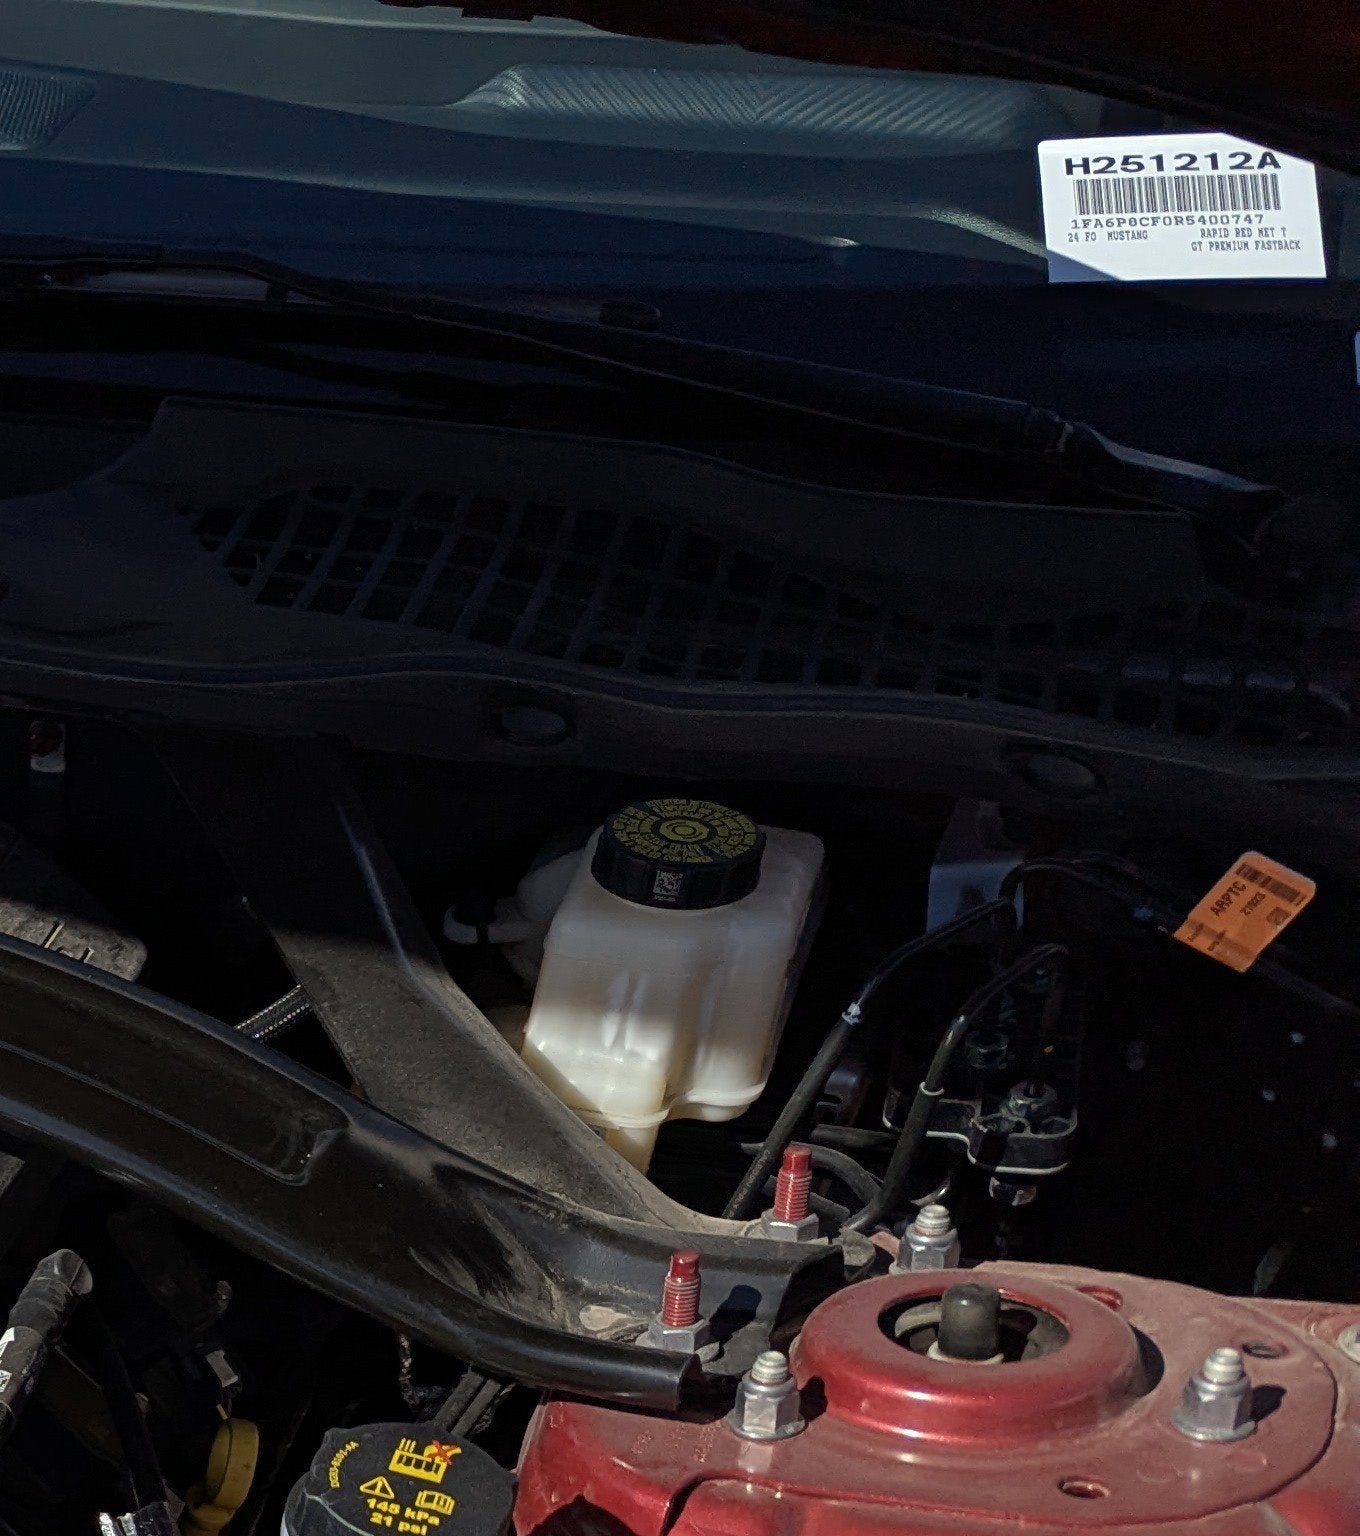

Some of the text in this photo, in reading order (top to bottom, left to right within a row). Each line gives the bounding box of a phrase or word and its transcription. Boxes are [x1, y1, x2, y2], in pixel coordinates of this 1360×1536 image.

[1064, 151, 1281, 175] H251212A
[1070, 214, 1264, 229] 1FA6P8CF0R5400747
[1067, 232, 1079, 242] 24
[1107, 230, 1148, 241] MUSTANG
[1200, 226, 1288, 238] RAPID RED MET T
[1191, 239, 1301, 251] GT PREMIUM FASTBACK
[370, 1511, 428, 1536] 21 psi
[405, 1506, 440, 1526] kPa
